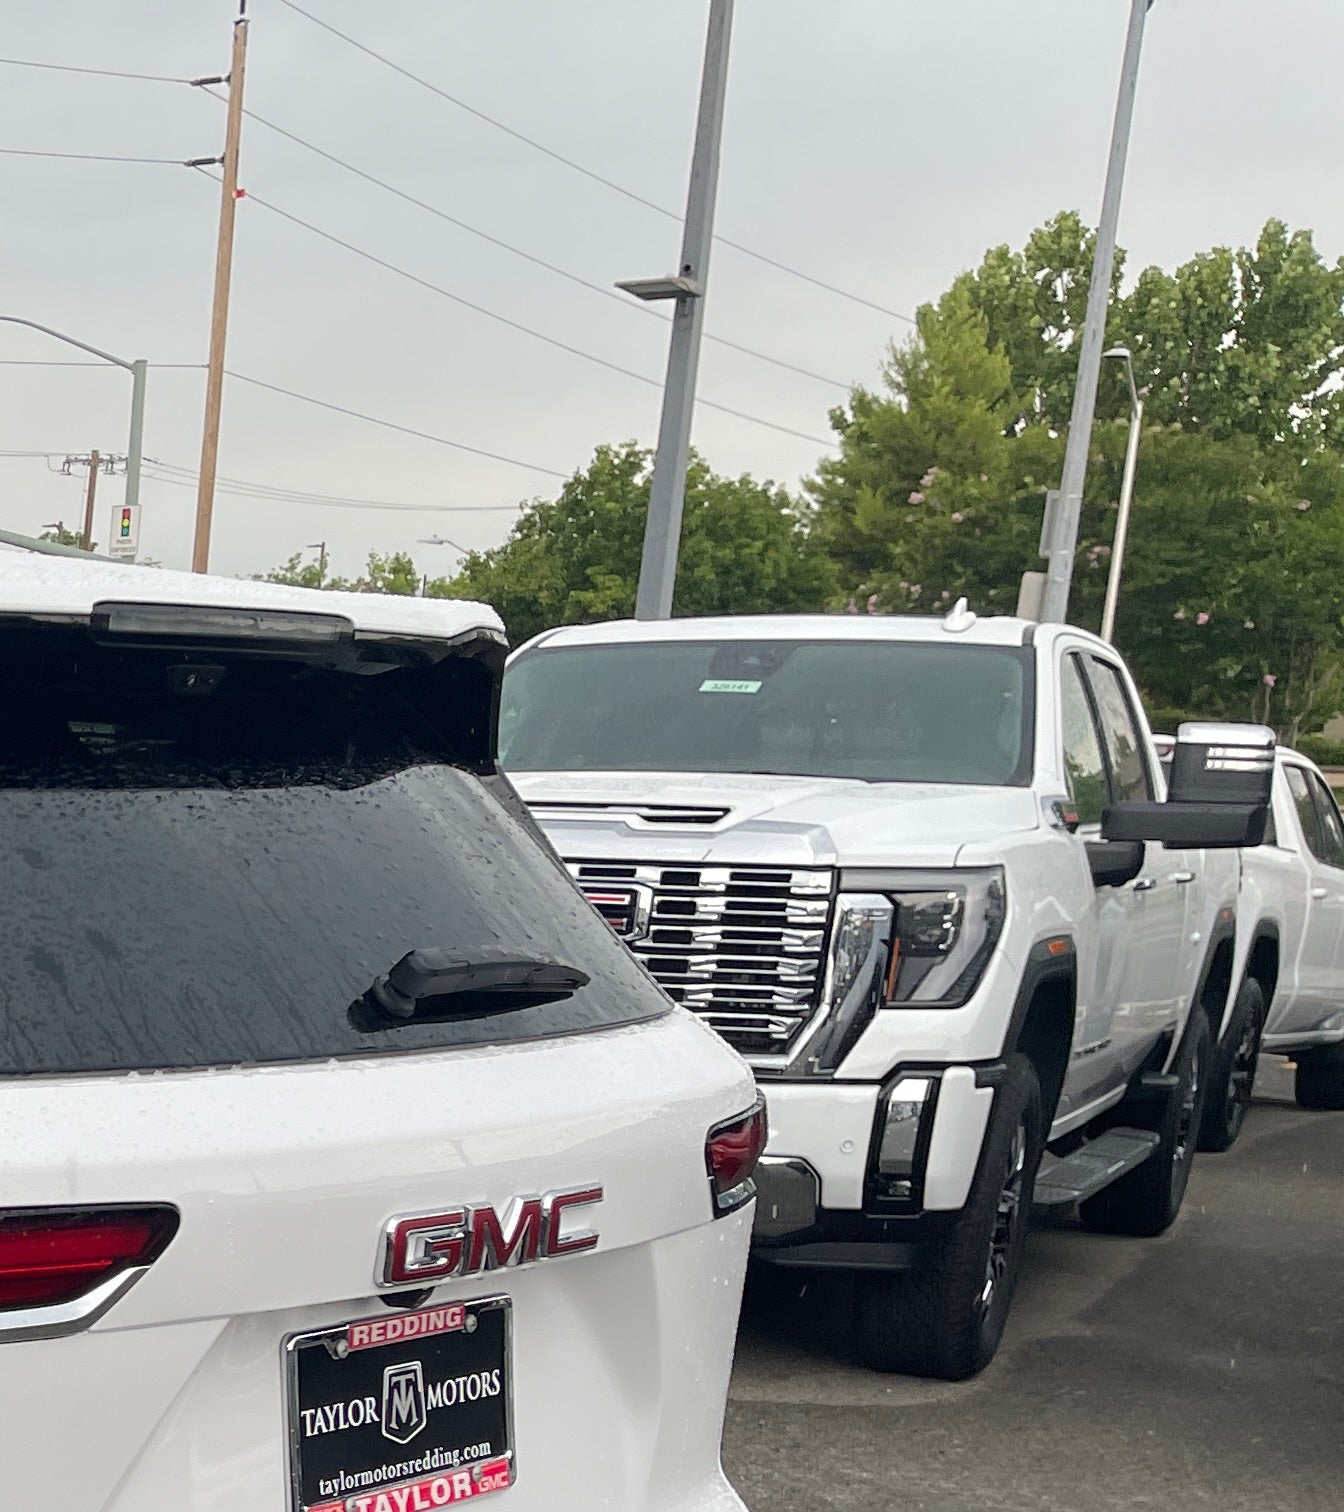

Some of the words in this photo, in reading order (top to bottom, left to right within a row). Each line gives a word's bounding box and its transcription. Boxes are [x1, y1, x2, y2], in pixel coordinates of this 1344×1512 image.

[374, 1182, 604, 1288] GMC
[351, 1307, 464, 1347] REDDING
[300, 1396, 380, 1437] TAYLOR
[427, 1369, 501, 1410] MOTORS
[319, 1442, 492, 1496] taylormotorsredding.com
[478, 1472, 509, 1492] GMC
